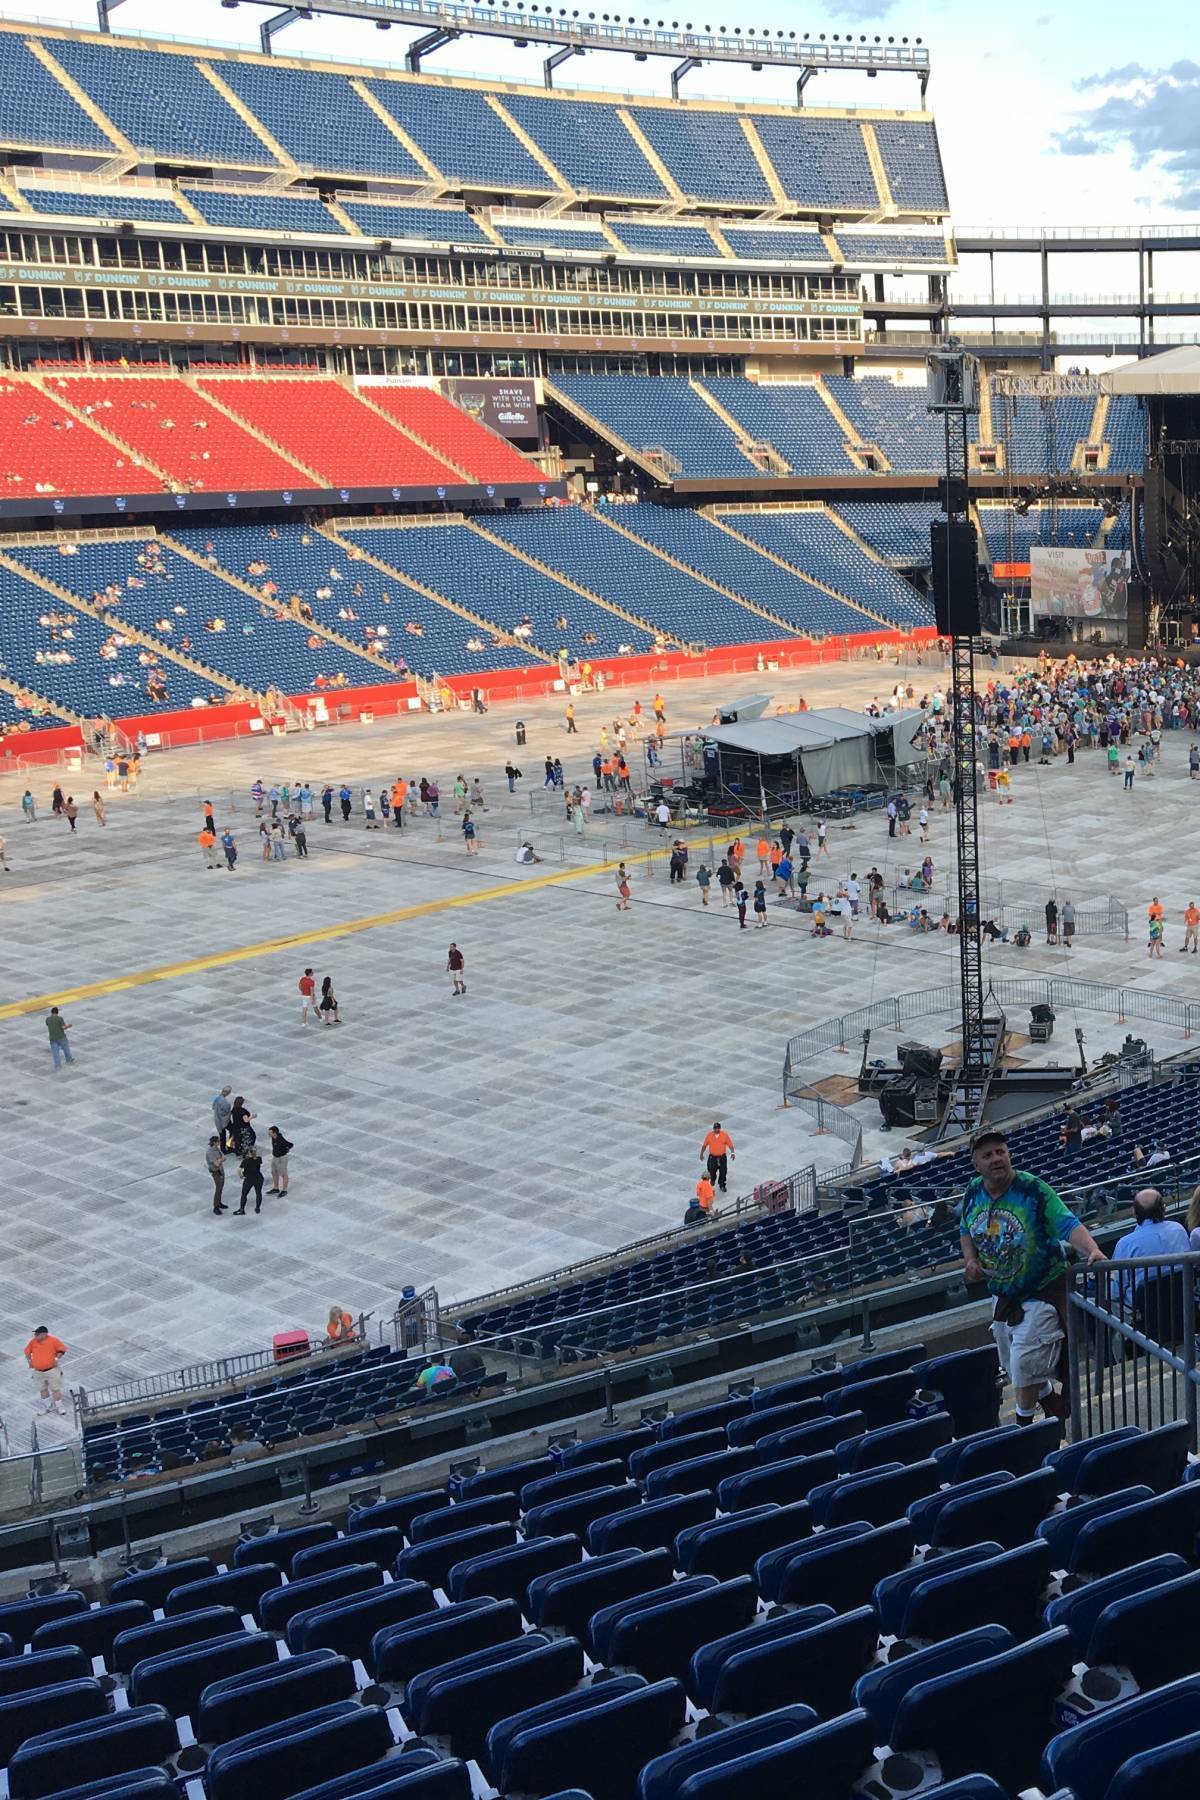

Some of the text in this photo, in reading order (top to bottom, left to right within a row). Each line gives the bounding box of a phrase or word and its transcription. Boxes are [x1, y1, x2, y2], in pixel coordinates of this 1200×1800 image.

[19, 270, 66, 281] DUNKIN'
[94, 273, 140, 284] DUNKIN'
[168, 277, 211, 288] DUNKIN'
[237, 280, 278, 291] DUNKIN'
[304, 283, 344, 294] DUNKIN'
[368, 286, 406, 296] DUNKIN'
[430, 289, 467, 299] DUNKIN'
[490, 292, 526, 302] DUNKIN'
[547, 294, 583, 305] DUNKIN'
[604, 297, 638, 307] DUNKIN'
[658, 300, 693, 309] DUNKIN'
[714, 301, 748, 311] DUNKIN'
[769, 303, 805, 312] DUNKIN'
[826, 304, 861, 313] DUNKIN'
[498, 412, 525, 420] Gillette
